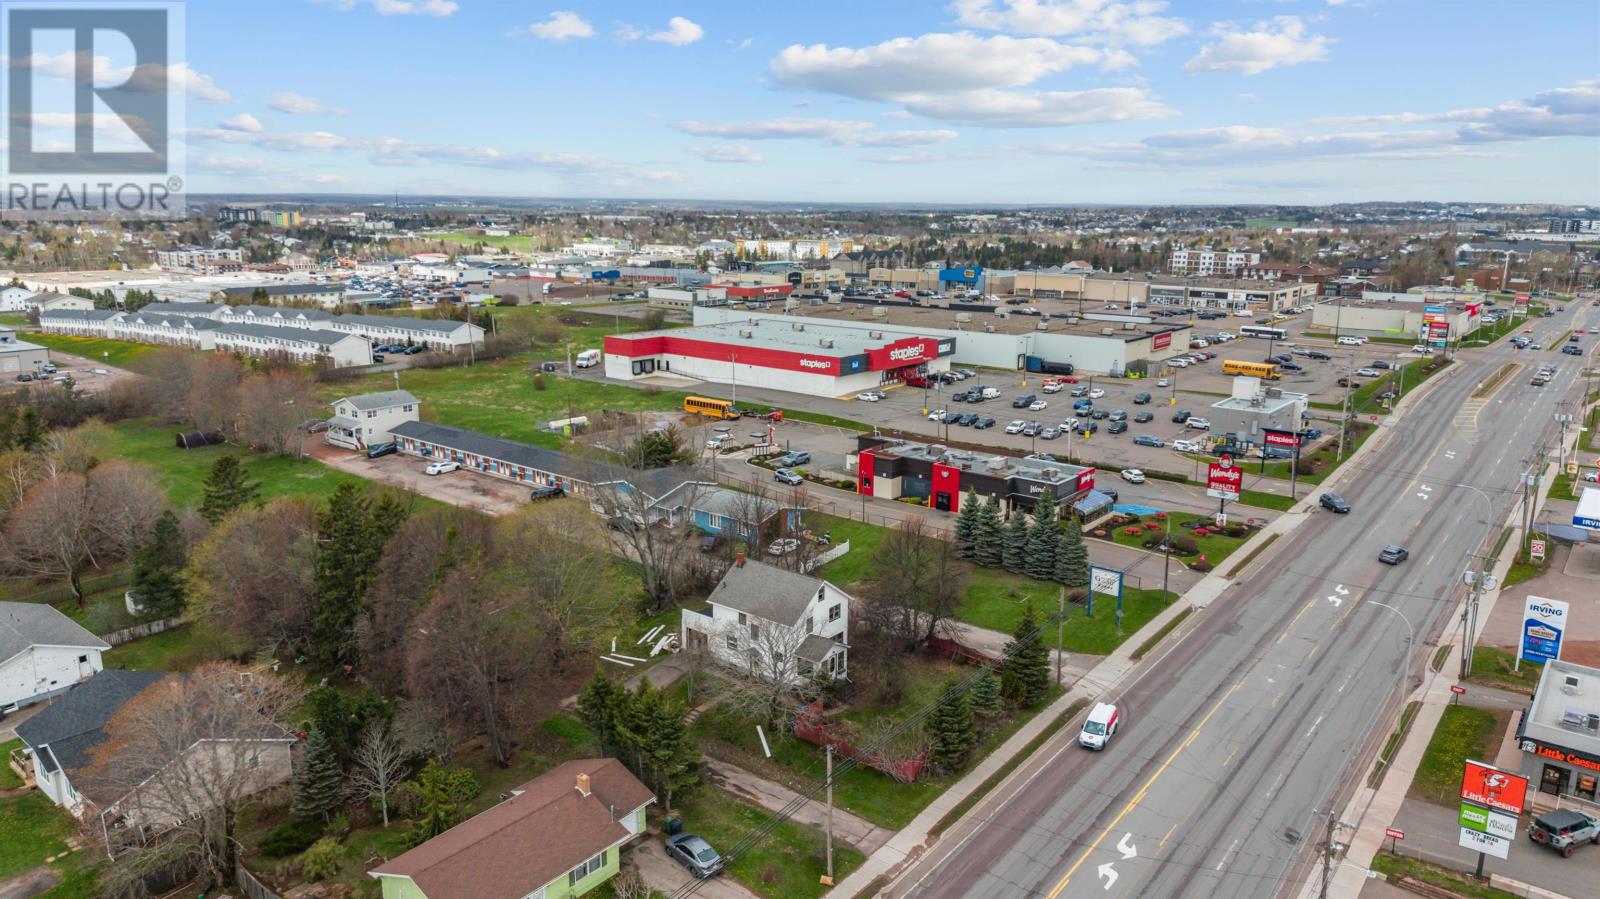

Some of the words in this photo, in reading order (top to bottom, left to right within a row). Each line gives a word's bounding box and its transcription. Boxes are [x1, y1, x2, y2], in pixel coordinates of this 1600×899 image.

[890, 345, 919, 361] staples
[800, 359, 826, 369] staples
[1210, 468, 1240, 480] Wendy's
[1211, 482, 1236, 491] QUALITY
[1532, 544, 1544, 552] 20
[1530, 604, 1563, 616] IRVING
[1536, 745, 1565, 761] Little
[1463, 790, 1487, 804] Little
[1486, 797, 1521, 814] Caesars
